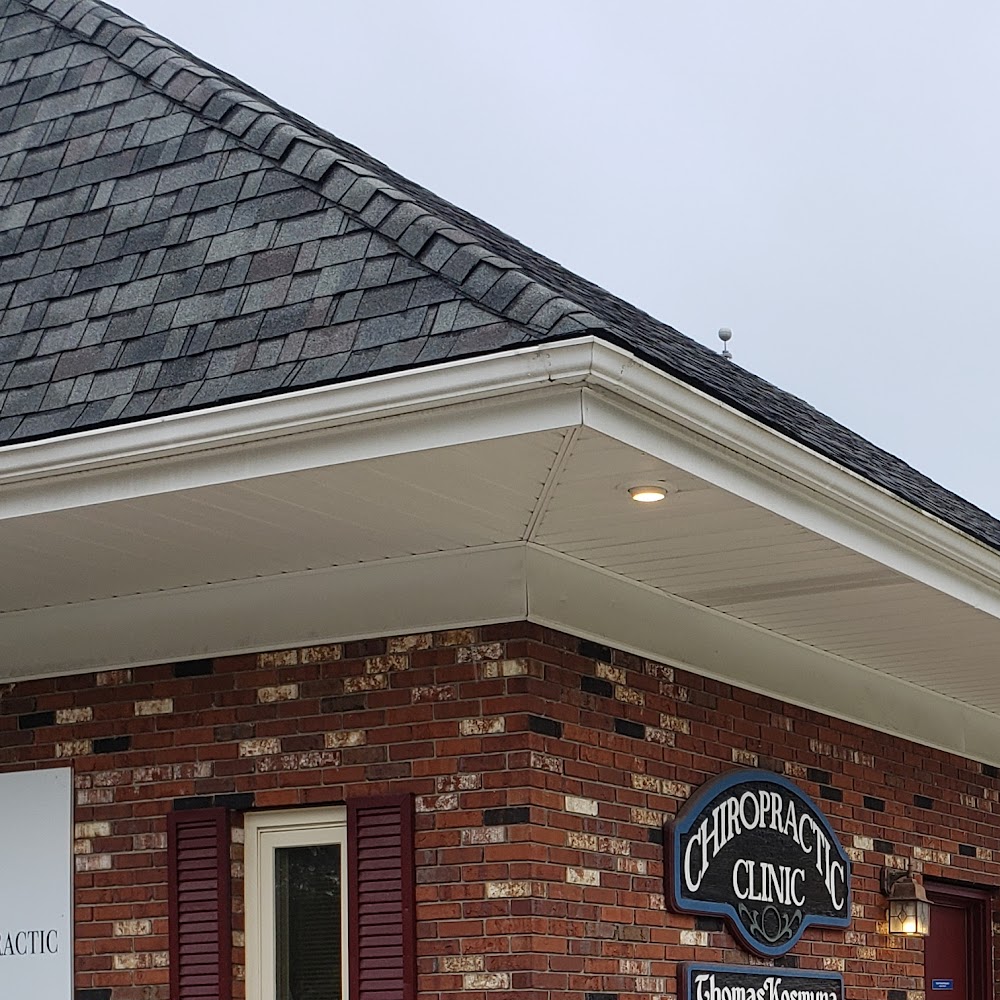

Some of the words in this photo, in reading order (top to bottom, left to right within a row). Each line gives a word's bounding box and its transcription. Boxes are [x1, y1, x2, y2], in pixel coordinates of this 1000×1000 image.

[684, 790, 844, 910] CHIROPRACTIC
[732, 858, 805, 907] CLINIC
[0, 929, 59, 956] ACTIC
